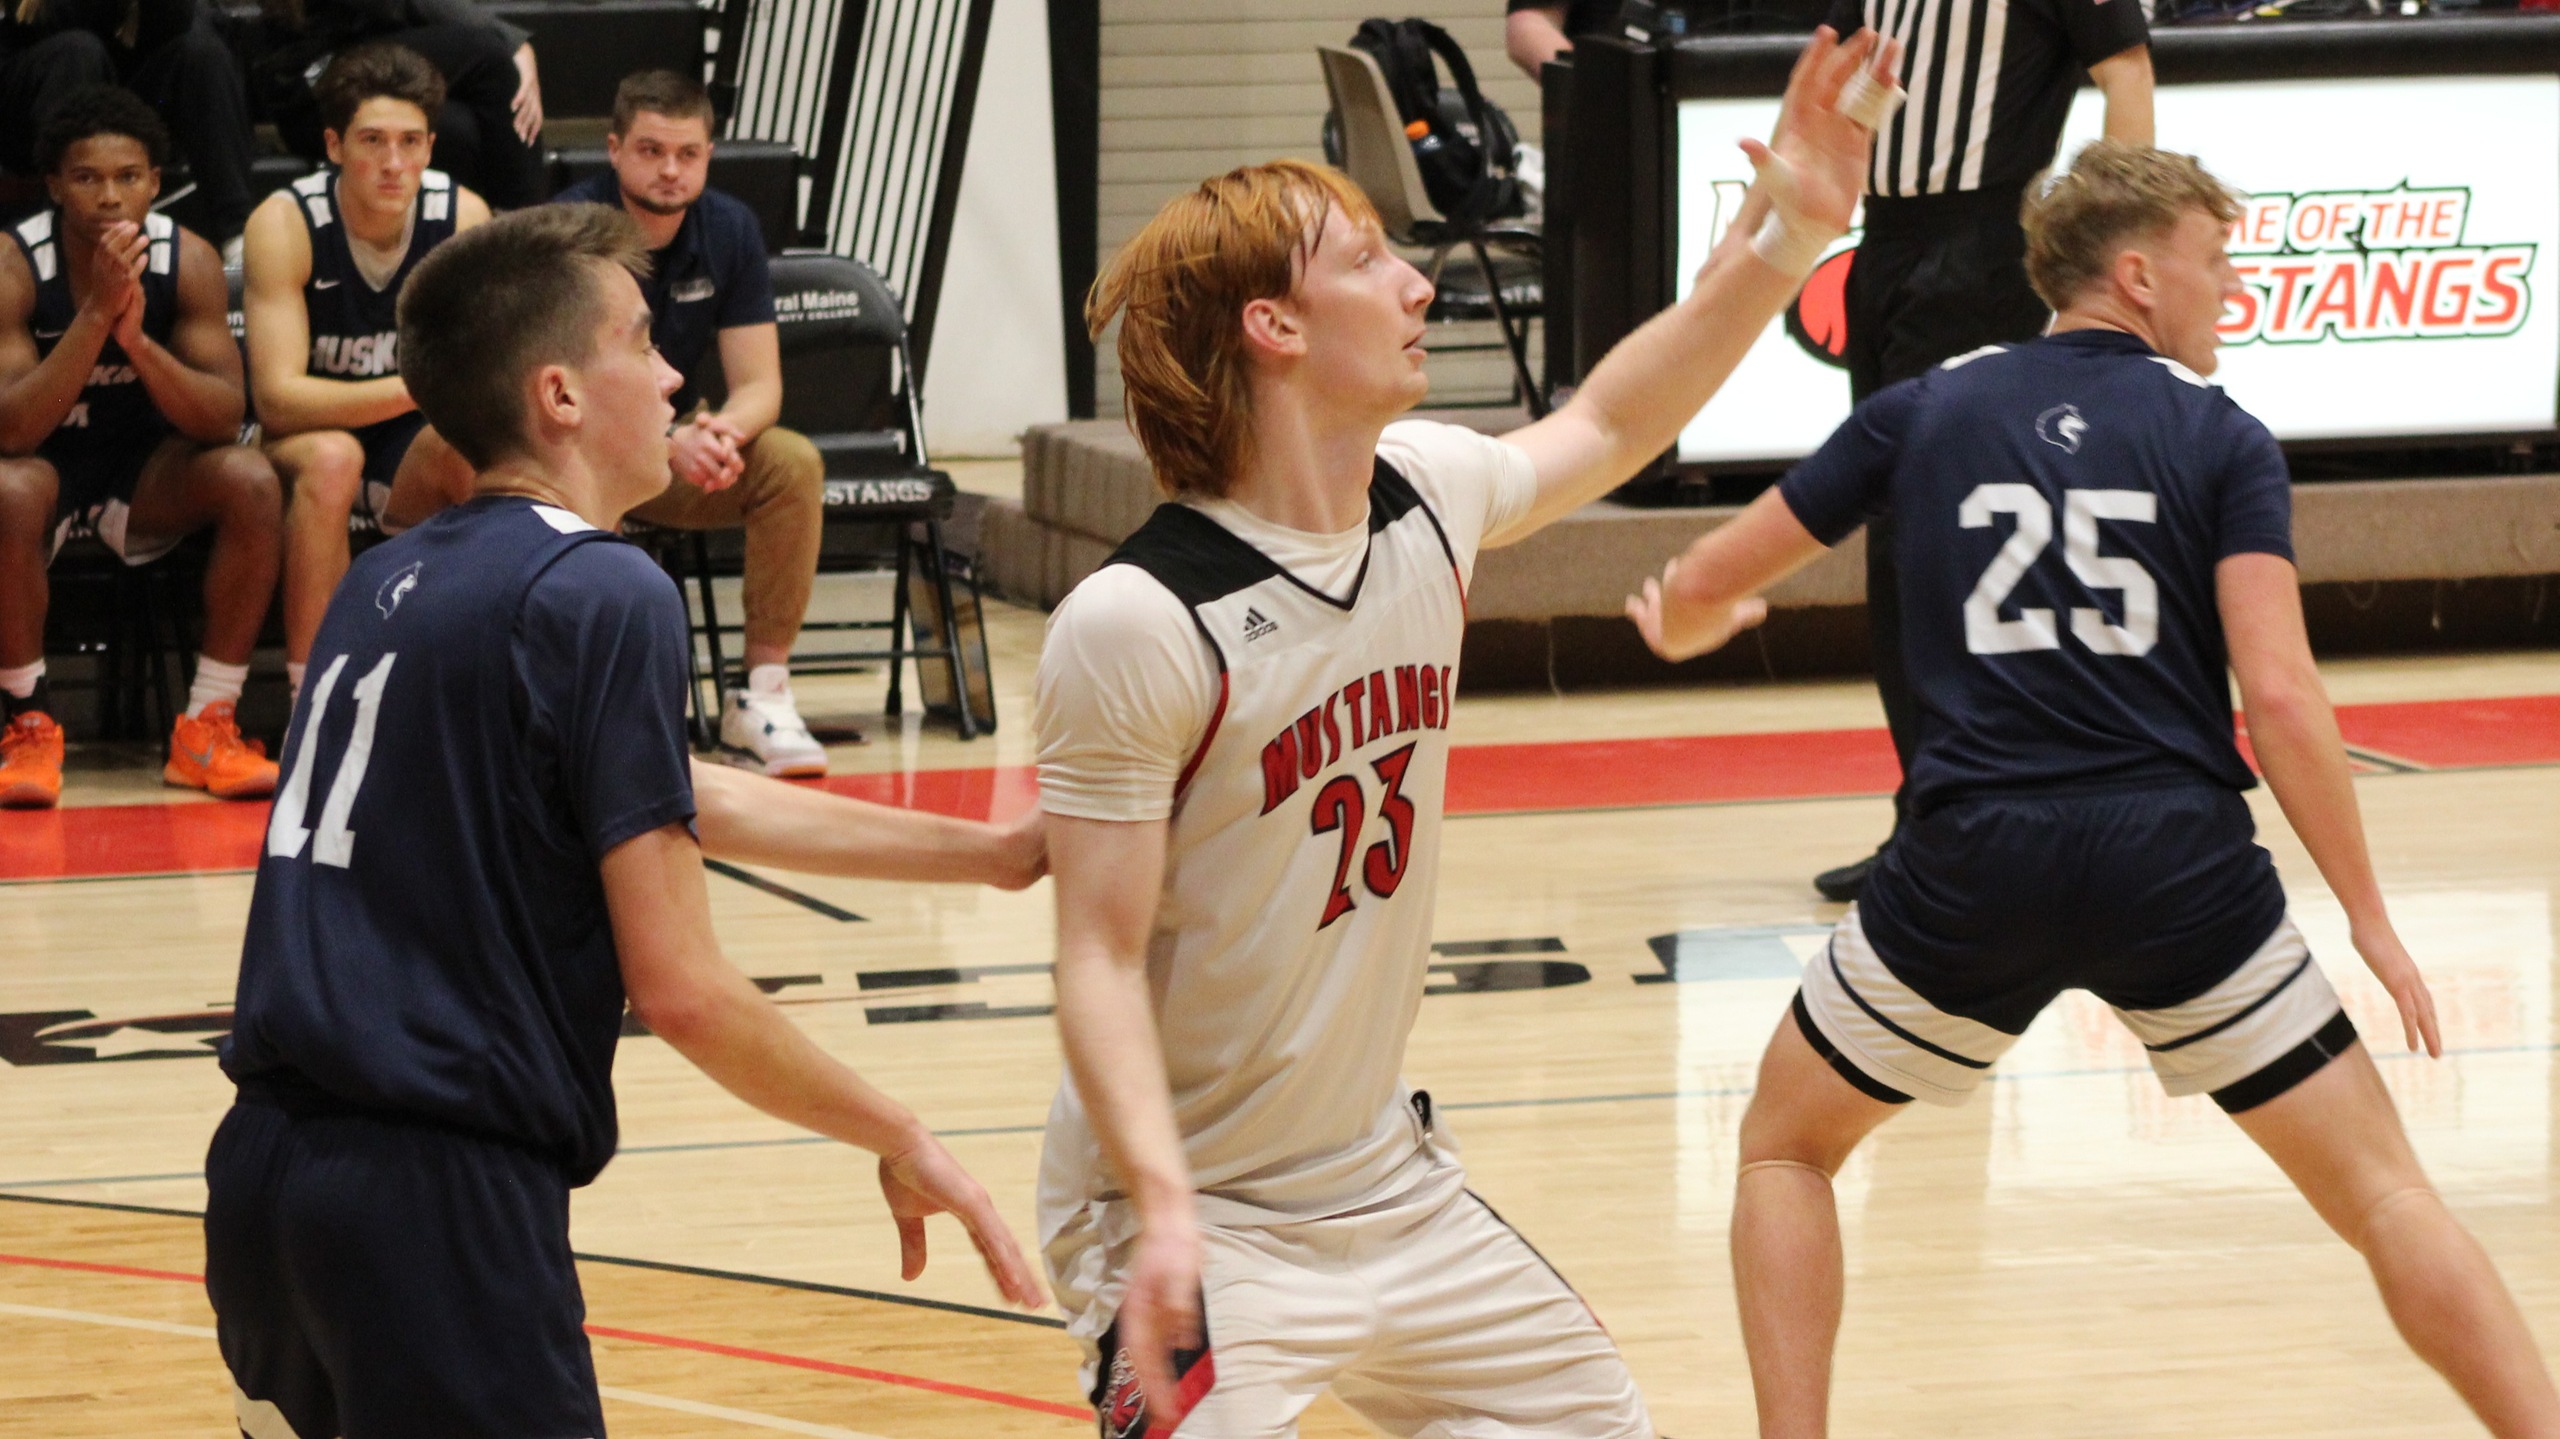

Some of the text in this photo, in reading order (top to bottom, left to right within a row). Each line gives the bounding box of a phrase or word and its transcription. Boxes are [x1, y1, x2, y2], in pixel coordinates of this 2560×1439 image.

[802, 290, 859, 309] Maine
[2296, 203, 2355, 242] OF
[2370, 199, 2457, 240] THE
[1958, 483, 2159, 657] 25
[268, 652, 397, 869] 11
[1259, 664, 1451, 818] MUSTANGS
[1311, 740, 1418, 932] 23
